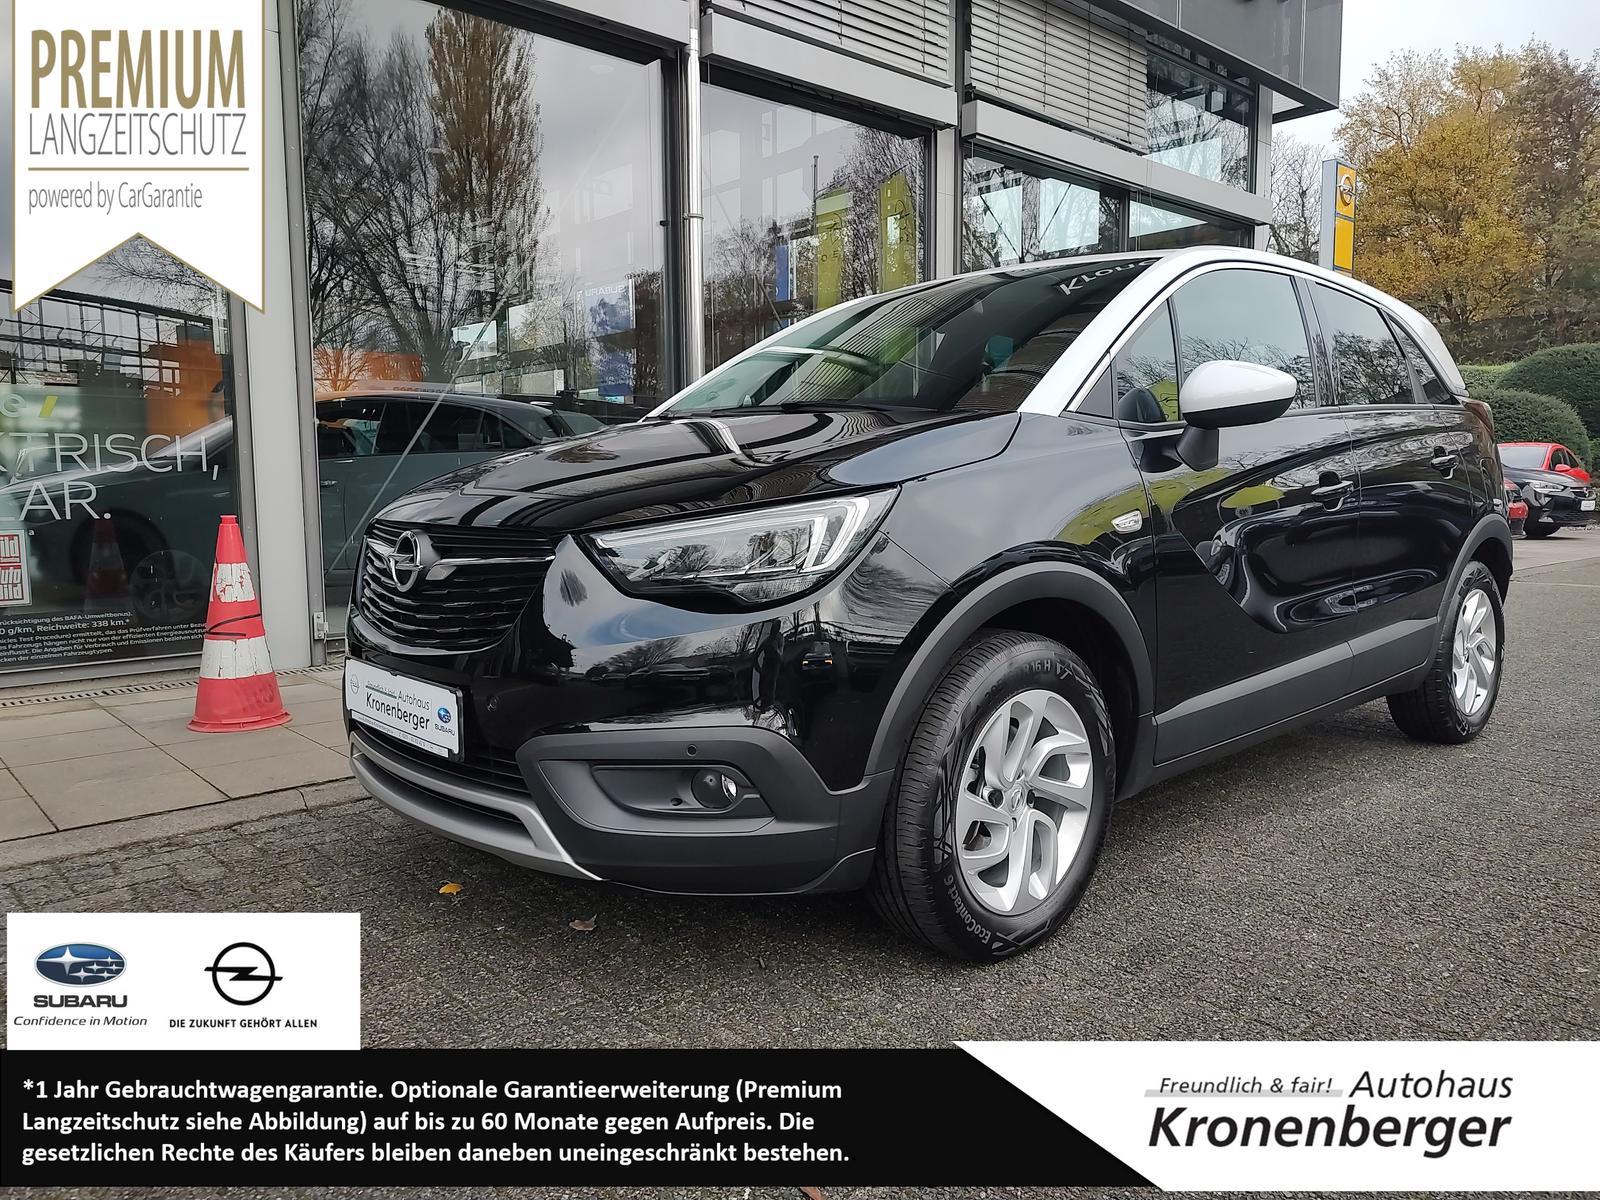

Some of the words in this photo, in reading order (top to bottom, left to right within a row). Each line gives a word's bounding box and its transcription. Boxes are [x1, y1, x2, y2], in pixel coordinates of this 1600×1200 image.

[0, 481, 112, 521] AR.
[8, 627, 35, 636] g/km,
[37, 621, 90, 632] Reichweite:
[91, 620, 109, 628] 338
[366, 691, 430, 730] Kronenberger
[397, 690, 430, 711] Autohaus
[947, 884, 992, 944] EcoContact
